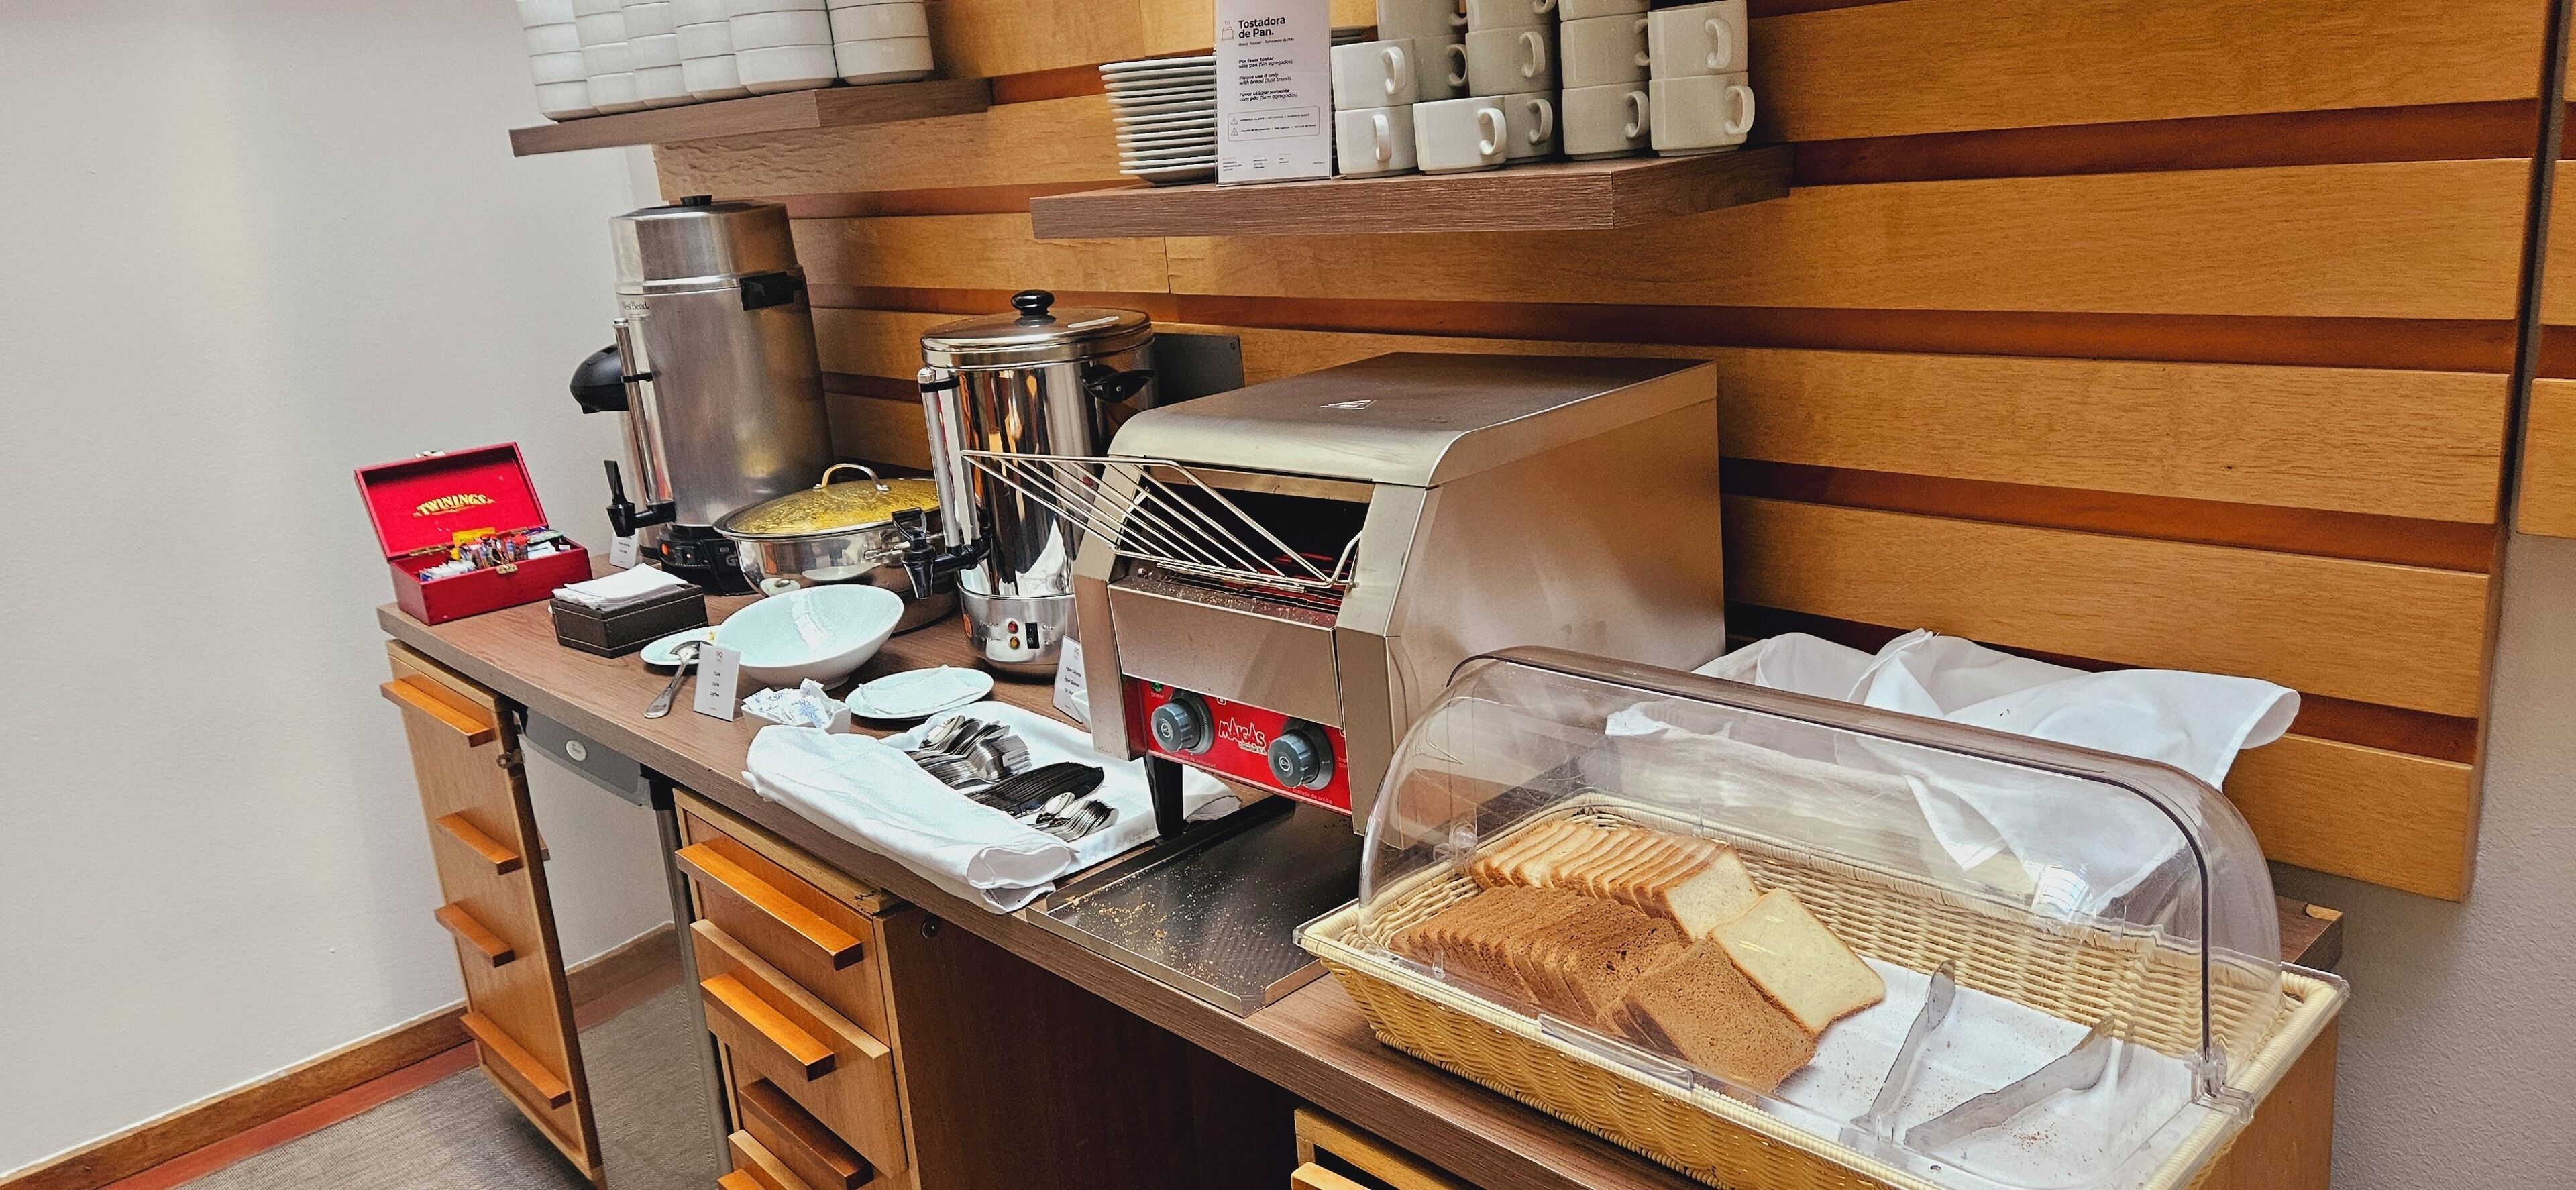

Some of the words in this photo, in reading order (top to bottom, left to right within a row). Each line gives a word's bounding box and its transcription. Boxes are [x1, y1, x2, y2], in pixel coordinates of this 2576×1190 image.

[1238, 16, 1285, 29] Tostadora
[1238, 29, 1250, 38] de
[1253, 28, 1274, 38] Pan.
[416, 494, 487, 516] TWININGS
